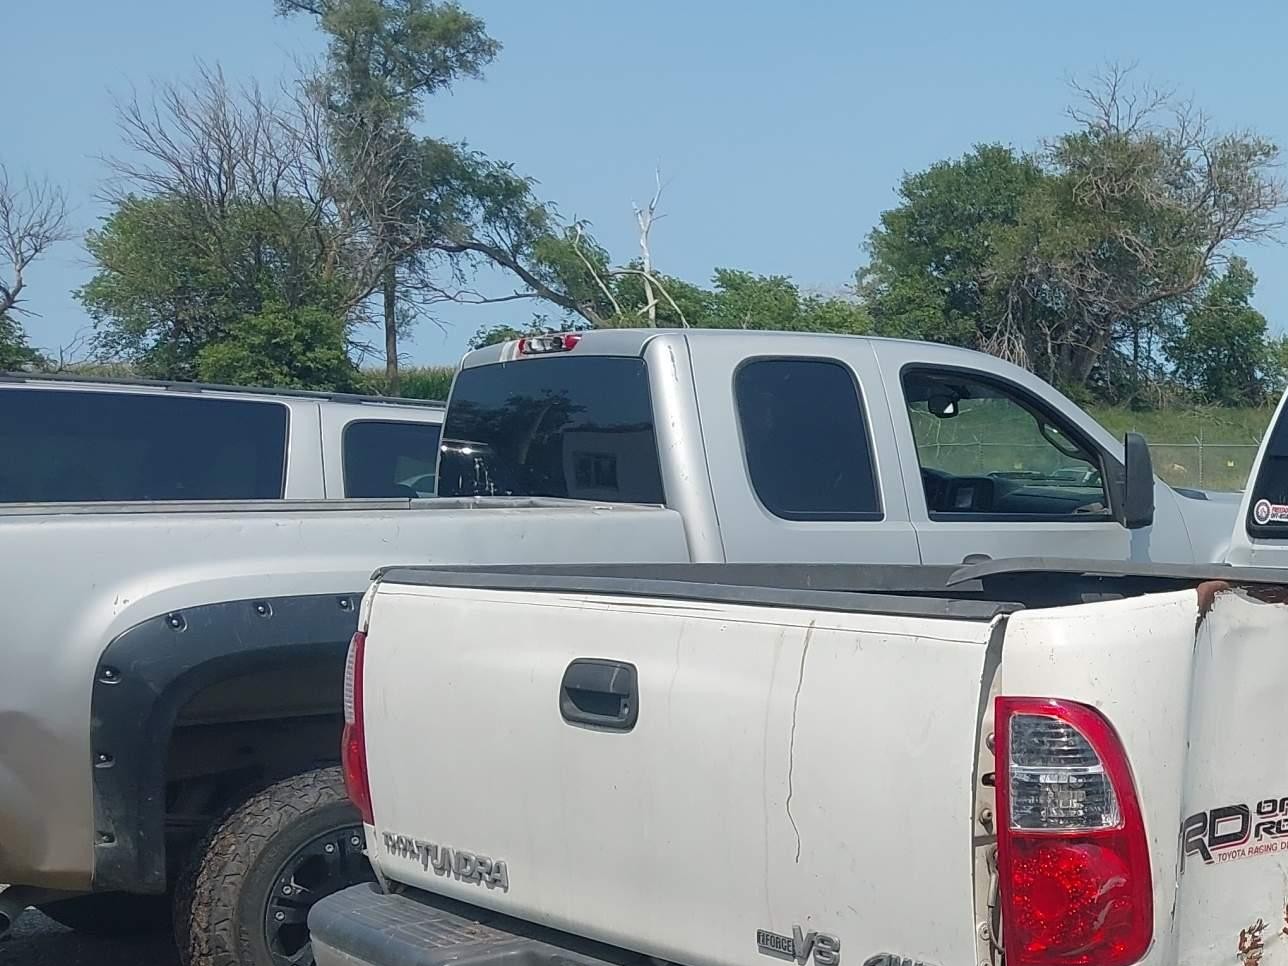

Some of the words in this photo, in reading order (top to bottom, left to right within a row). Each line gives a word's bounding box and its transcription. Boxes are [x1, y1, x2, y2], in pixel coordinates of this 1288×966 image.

[415, 839, 510, 894] TUNDRA
[1217, 848, 1246, 863] TOYOTA
[1247, 842, 1278, 857] RACING
